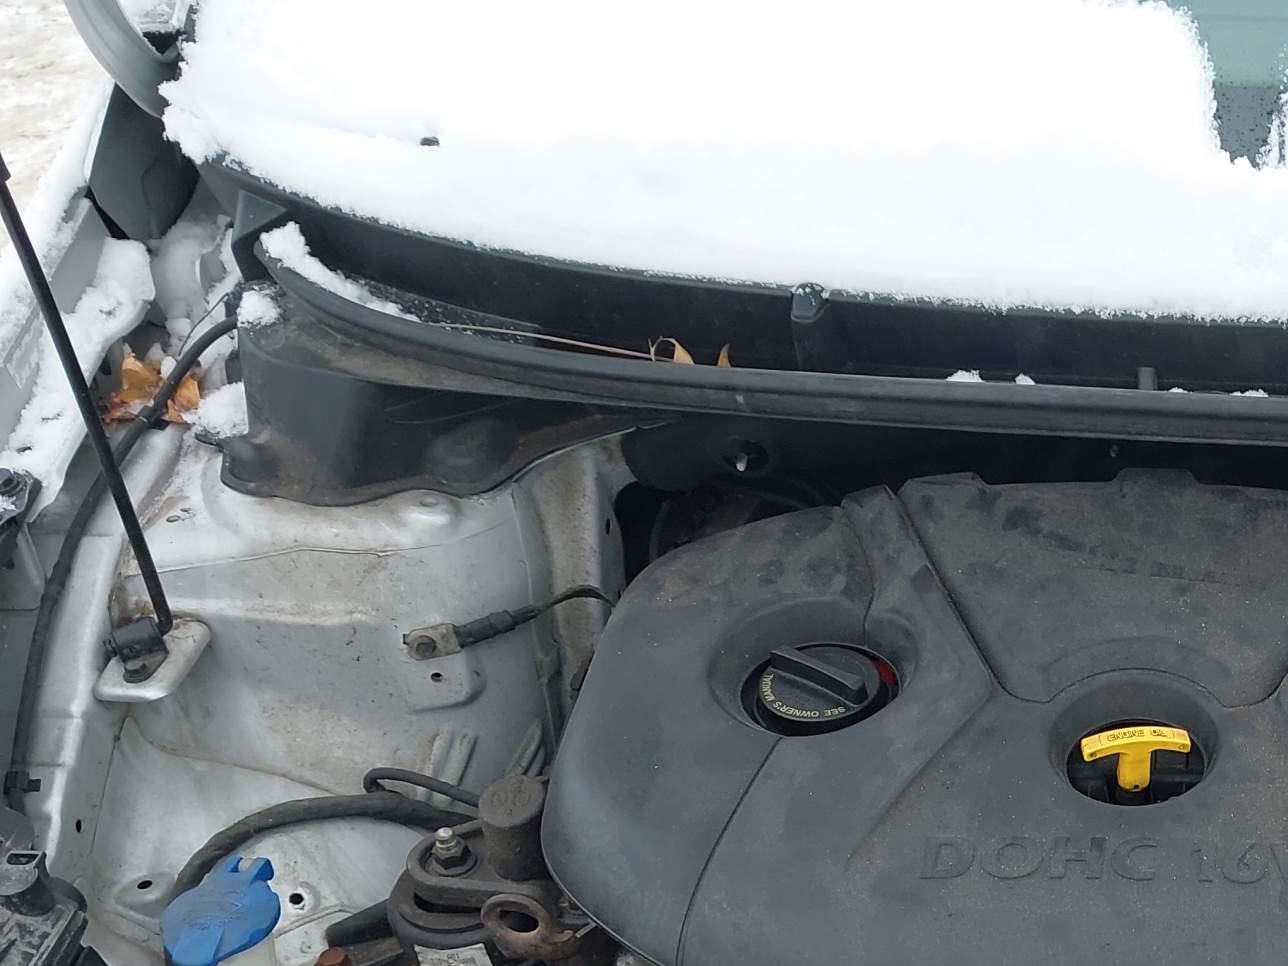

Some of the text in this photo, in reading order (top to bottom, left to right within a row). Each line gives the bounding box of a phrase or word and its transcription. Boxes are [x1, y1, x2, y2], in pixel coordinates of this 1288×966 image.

[761, 673, 846, 718] SEE OWNER'S MANUAL
[1107, 729, 1169, 742] ENGINE OIL
[918, 836, 1159, 882] DOHC
